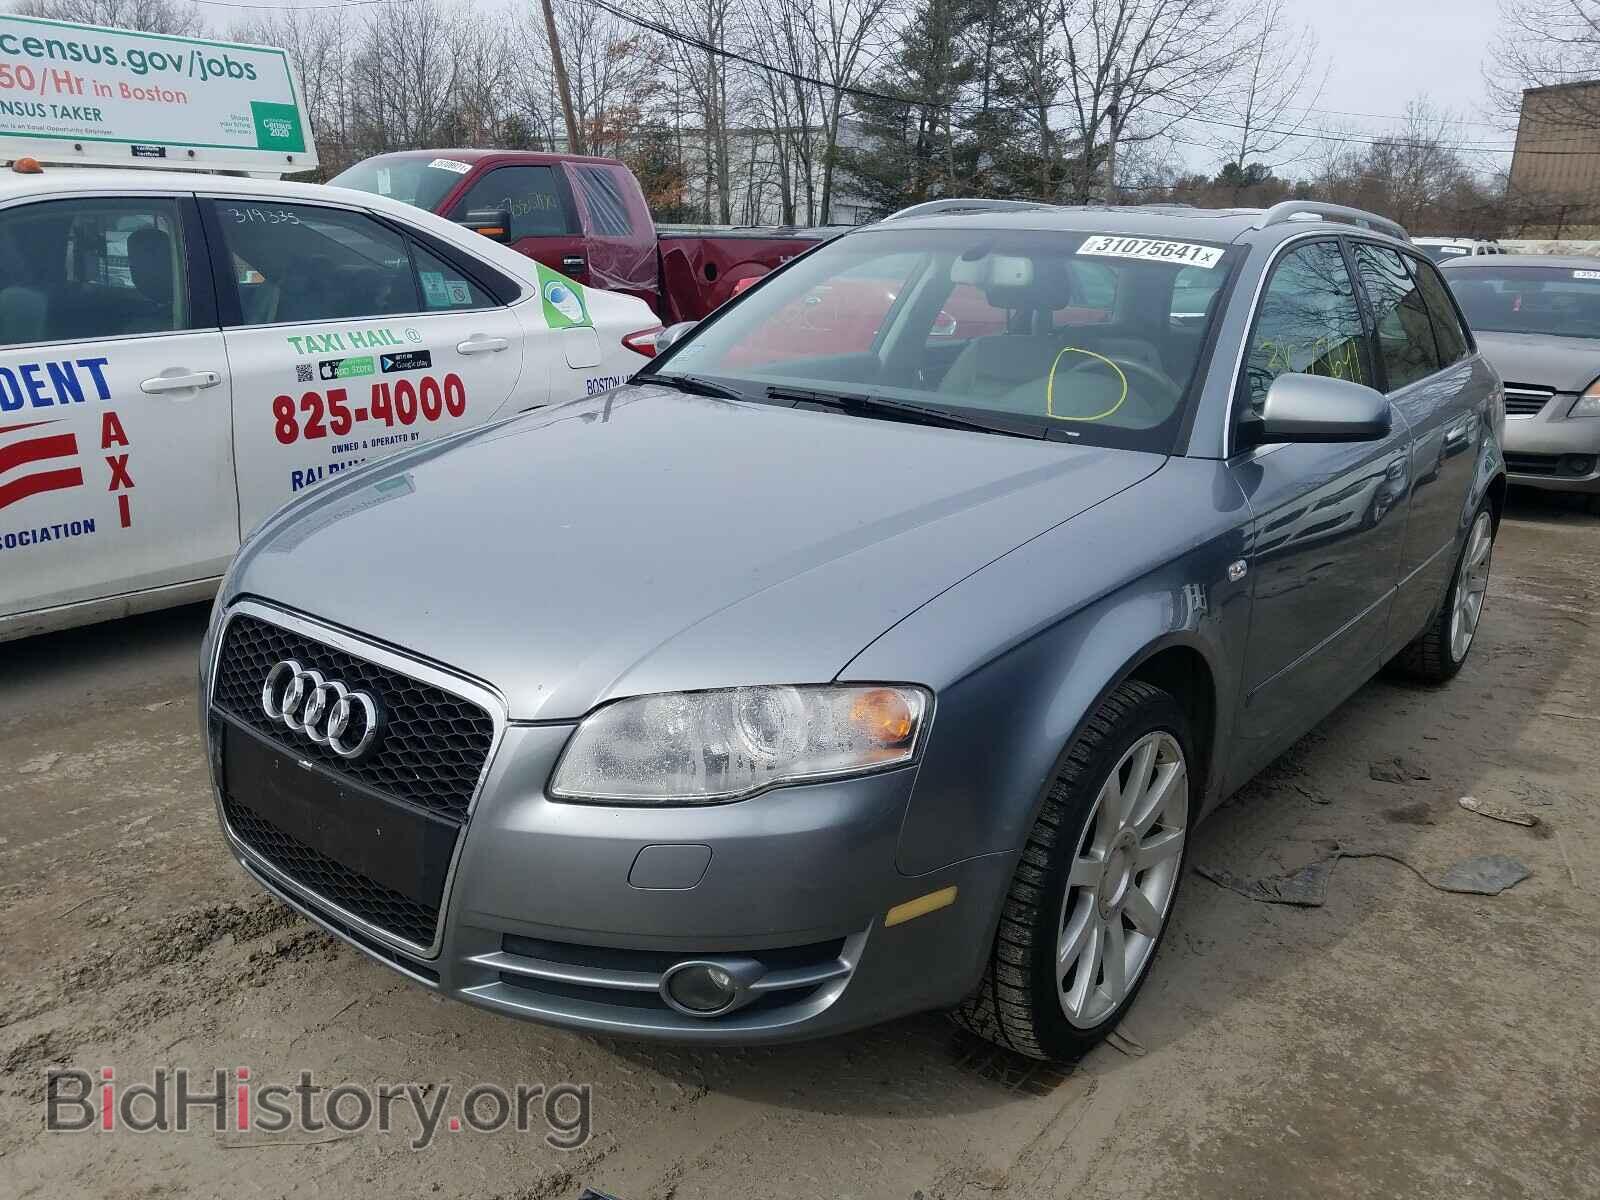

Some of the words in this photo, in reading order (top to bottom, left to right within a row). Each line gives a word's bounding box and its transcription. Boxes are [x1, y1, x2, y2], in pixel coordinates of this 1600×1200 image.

[0, 33, 257, 82] census.gov/jobs
[0, 64, 84, 97] 50/Hr
[92, 80, 112, 98] in
[120, 82, 187, 105] Boston
[50, 104, 103, 121] TAKER
[264, 118, 292, 130] Census
[270, 129, 289, 138] 2020
[1096, 237, 1203, 261] 31075641
[288, 333, 347, 355] TAXI
[348, 328, 403, 349] HAIL
[334, 366, 349, 376] App
[396, 359, 416, 369] Google
[586, 375, 620, 395] BOSTON
[272, 372, 467, 446] 825-4000
[331, 441, 359, 455] OWNED
[362, 440, 368, 449] &
[371, 433, 408, 448] OPERATED
[411, 432, 420, 441] BY
